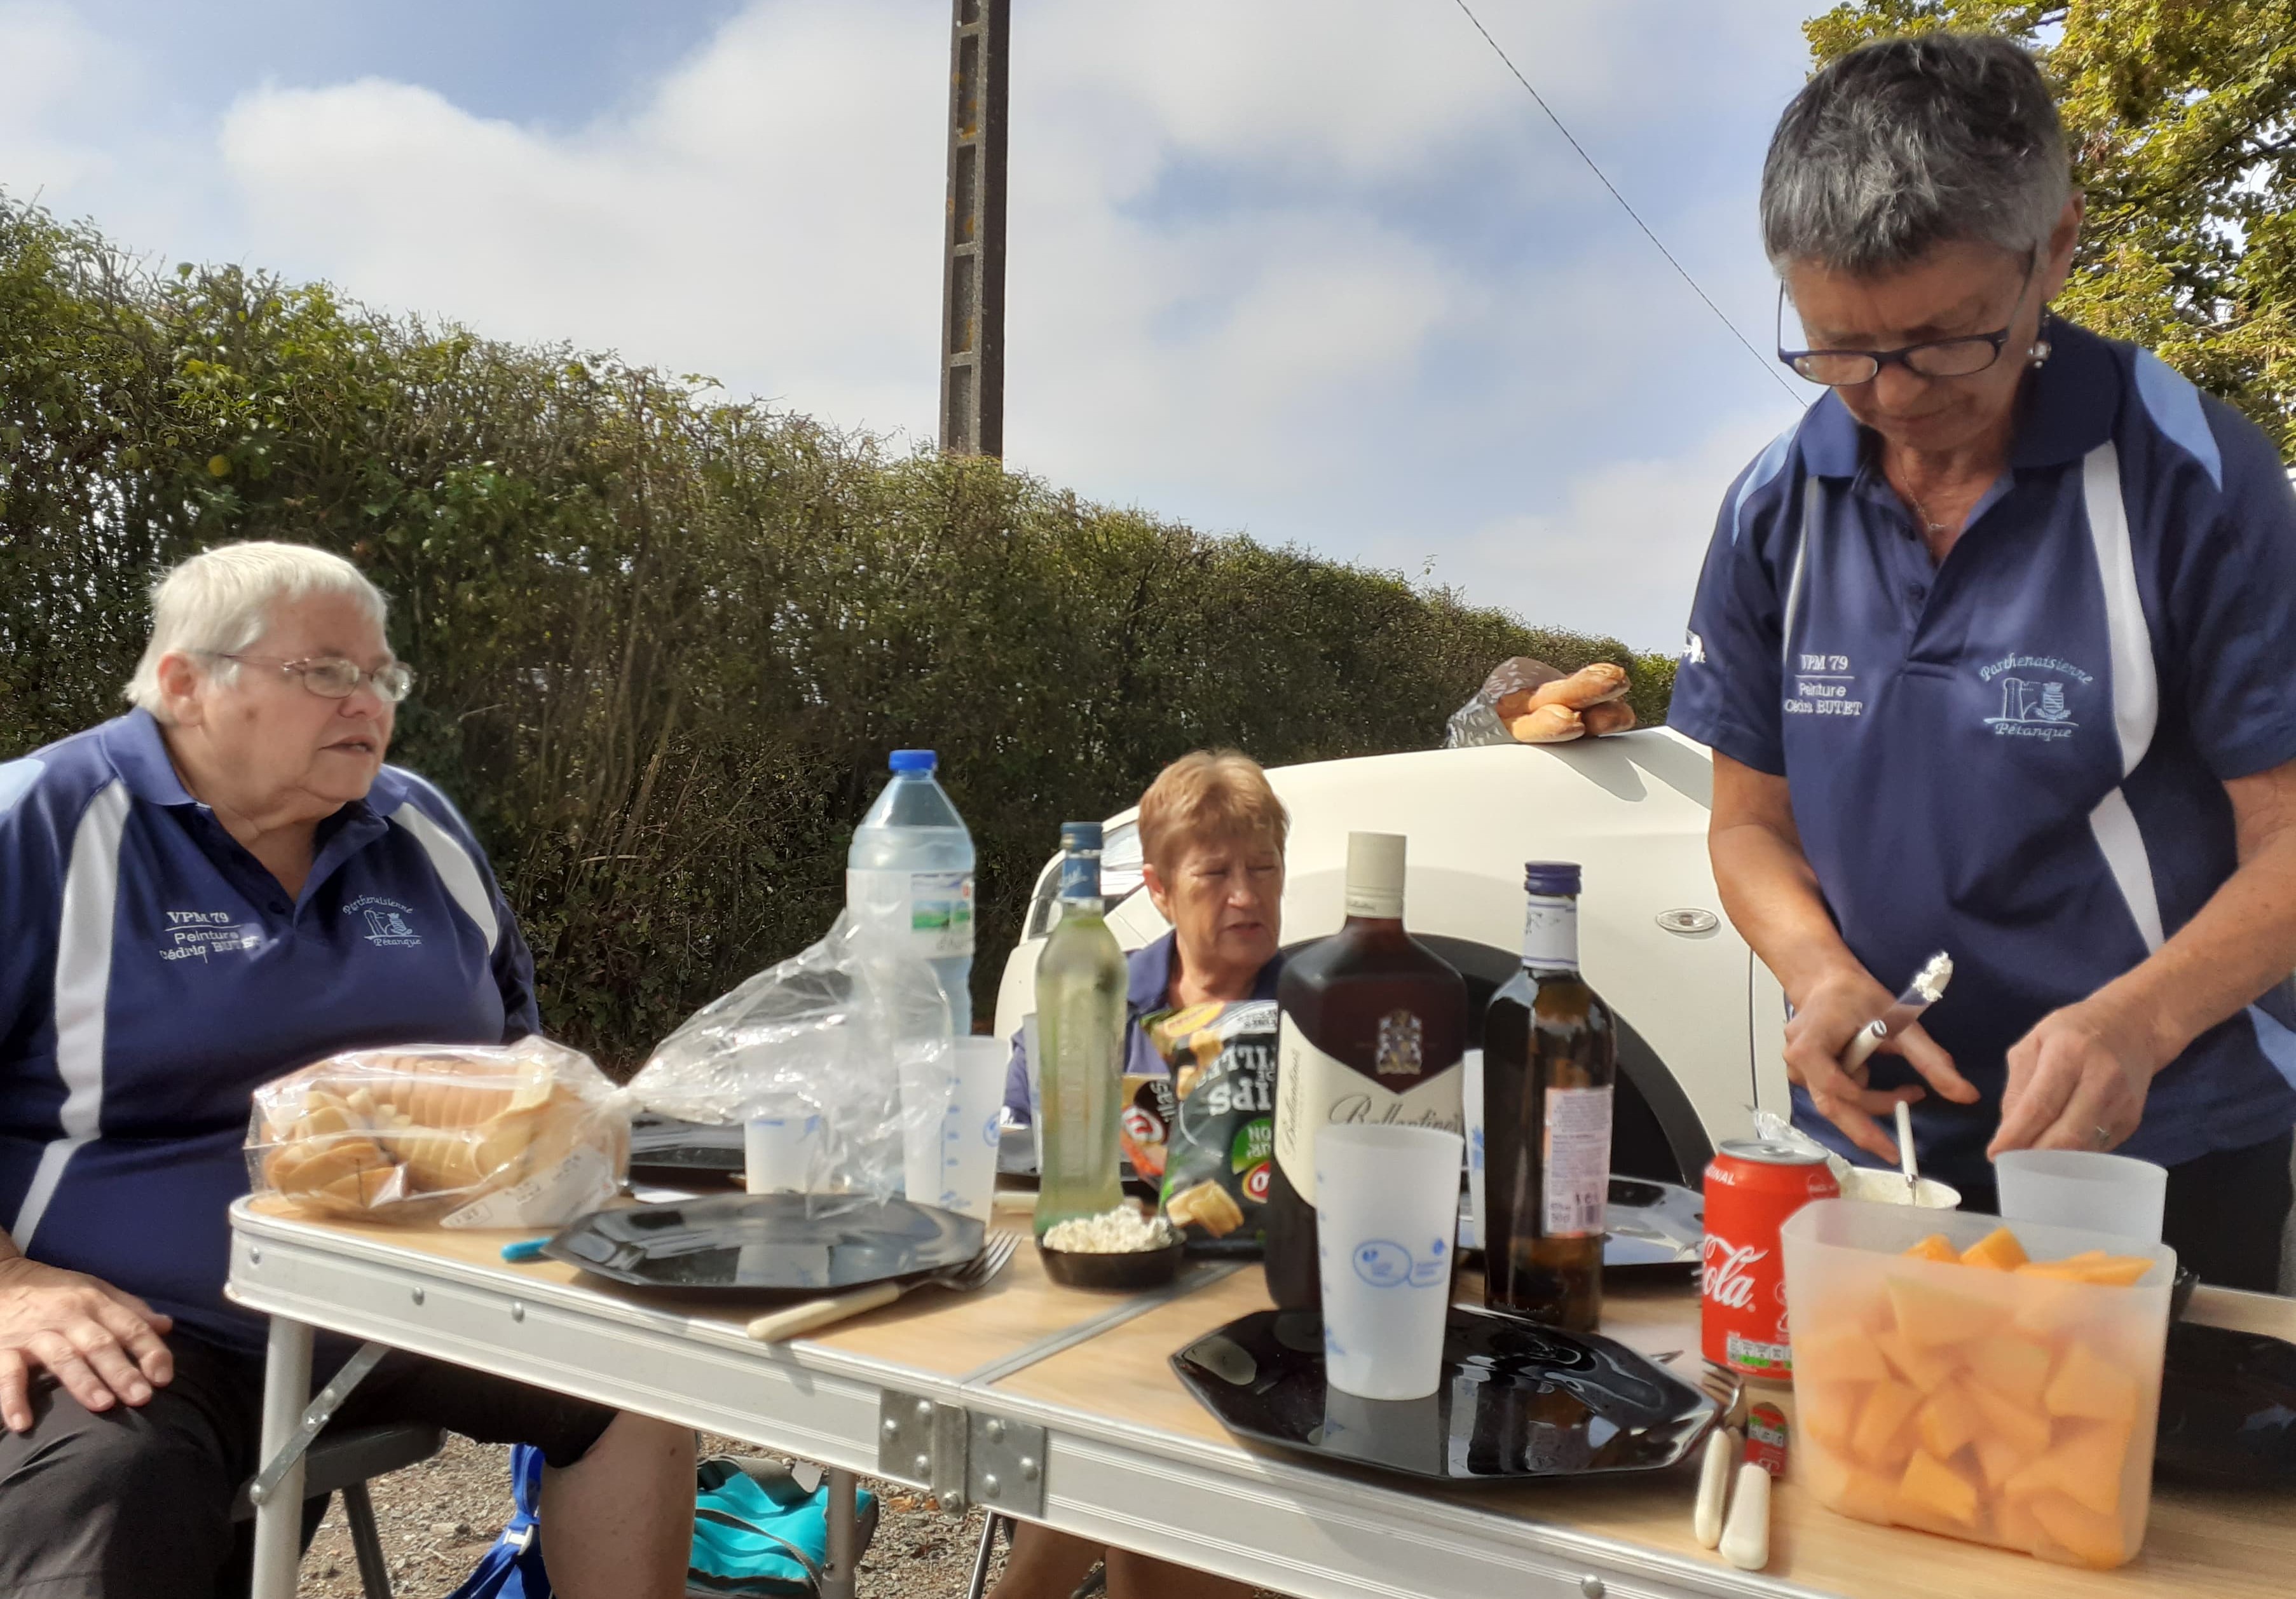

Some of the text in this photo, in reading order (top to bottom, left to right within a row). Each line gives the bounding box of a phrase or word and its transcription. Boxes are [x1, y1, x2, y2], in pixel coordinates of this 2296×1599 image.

[1800, 654, 1848, 670] VPM 79
[1799, 682, 1847, 697] Peinture
[1816, 699, 1862, 715] BUTET
[1995, 723, 2073, 741] Pétanque
[167, 912, 229, 923] VPM 79
[174, 931, 239, 945] Peinture
